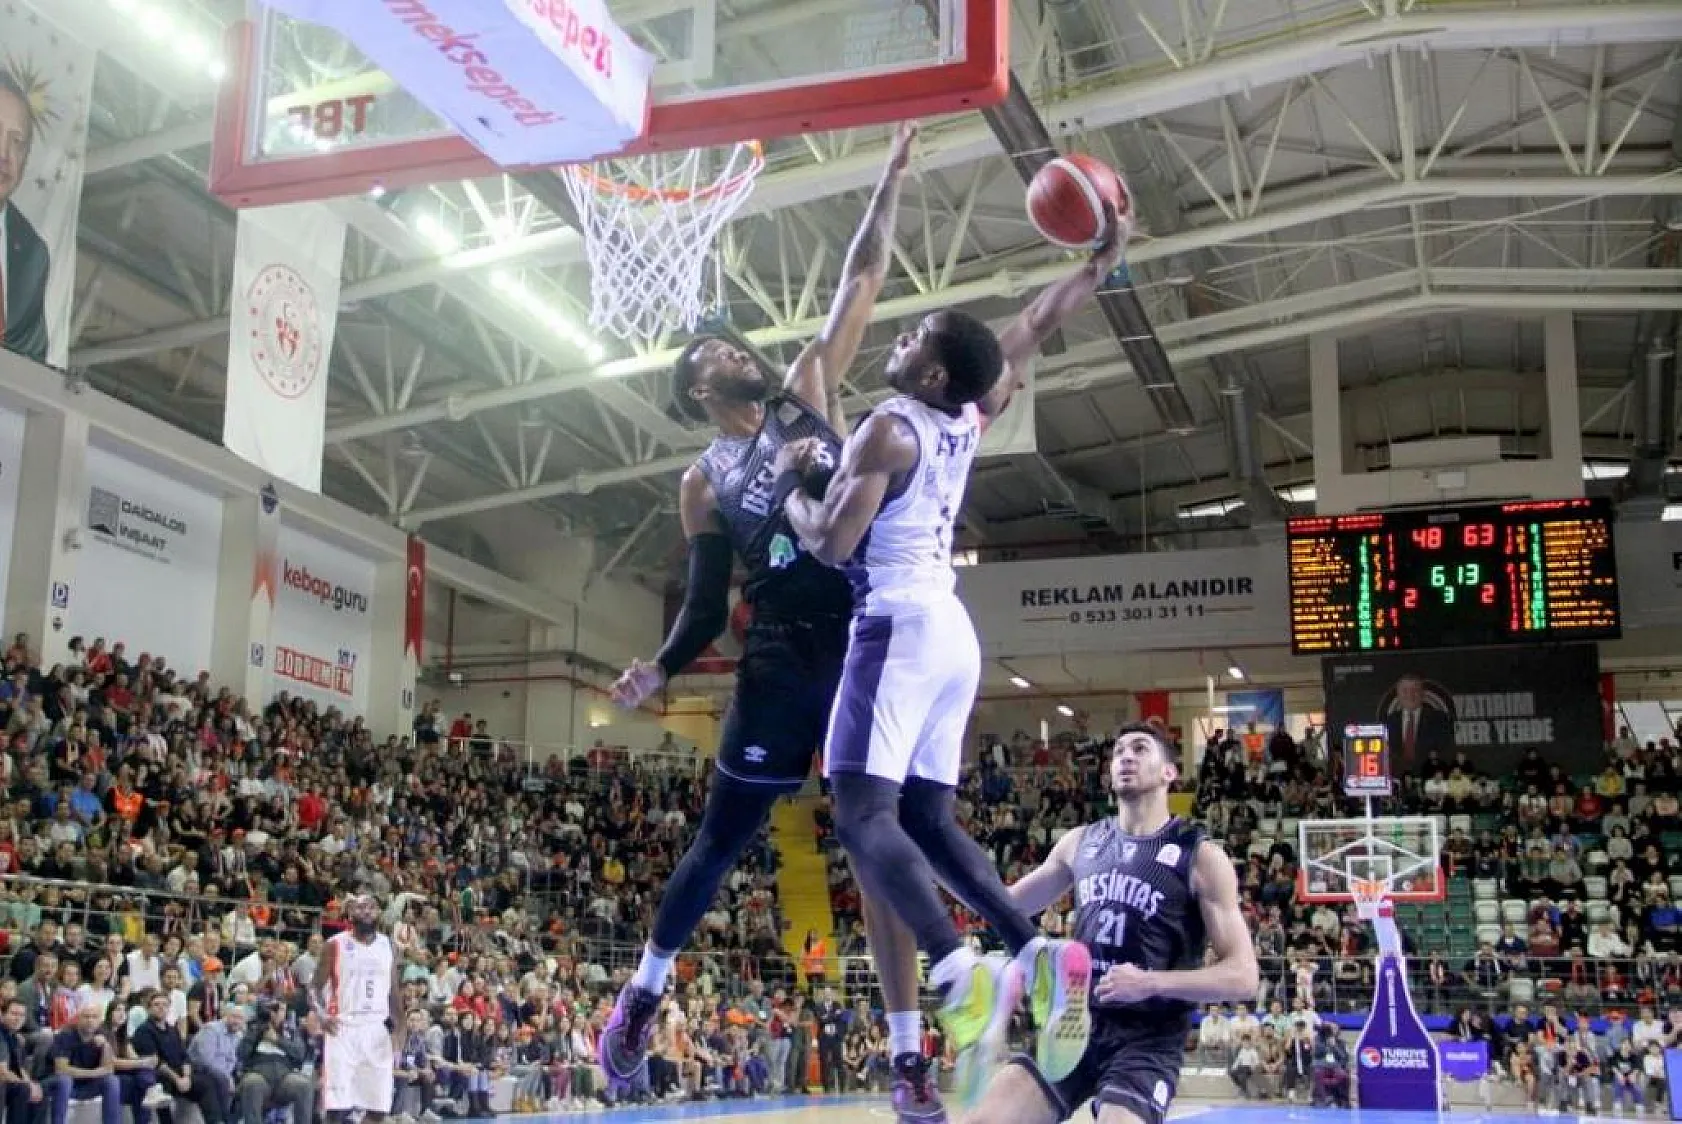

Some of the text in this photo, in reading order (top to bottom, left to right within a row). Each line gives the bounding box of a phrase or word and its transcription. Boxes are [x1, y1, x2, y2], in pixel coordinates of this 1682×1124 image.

[1412, 526, 1442, 550] 48
[1464, 523, 1495, 547] 63
[1431, 565, 1445, 587] 6
[1020, 577, 1254, 607] REKLAM ALANIDIR
[1405, 587, 1418, 609] 2
[1444, 585, 1454, 604] 3
[1482, 583, 1495, 604] 2
[1095, 908, 1126, 948] 21
